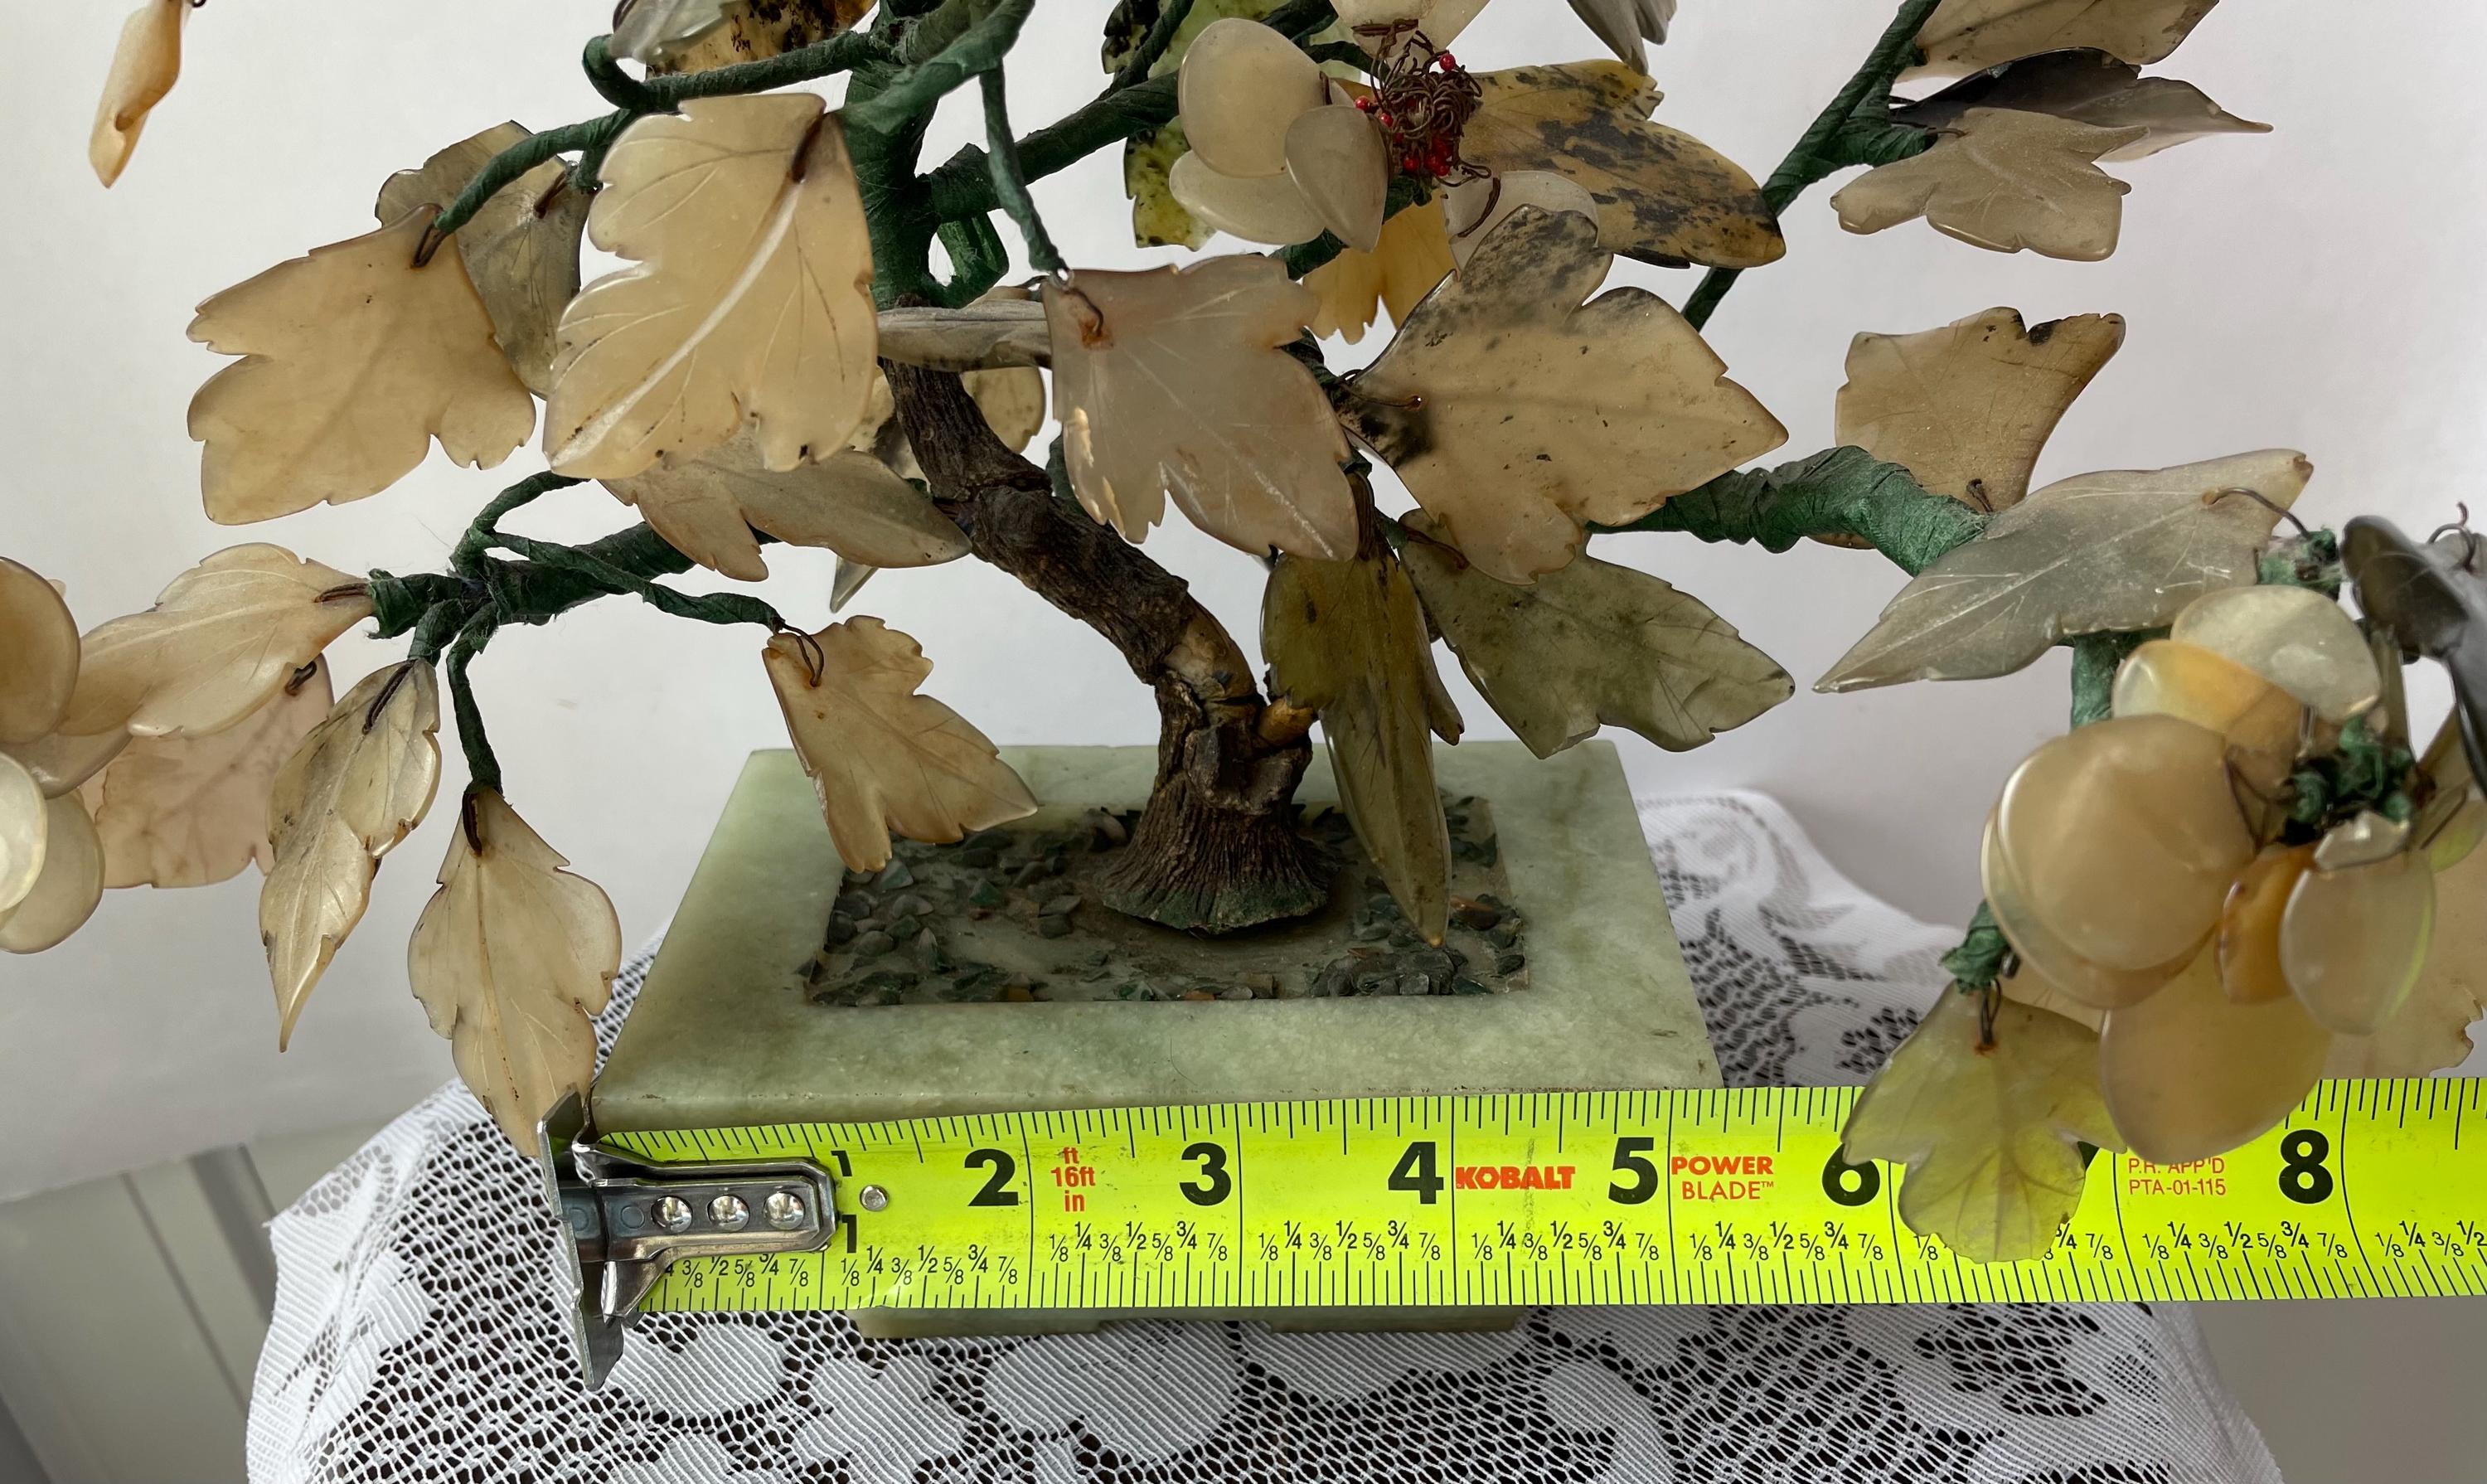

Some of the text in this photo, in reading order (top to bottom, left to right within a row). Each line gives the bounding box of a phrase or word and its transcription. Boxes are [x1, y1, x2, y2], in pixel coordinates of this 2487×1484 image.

[831, 1150, 853, 1177] 1
[1063, 1147, 1079, 1164] ft
[1179, 1142, 1232, 1206] 3
[1388, 1141, 1444, 1205] 4
[1607, 1137, 1659, 1205] 5
[1671, 1156, 1774, 1176] POWER
[1822, 1142, 1880, 1207] 6
[2278, 1128, 2334, 1205] 8
[964, 1148, 1019, 1207] 2
[1050, 1166, 1096, 1187] 16ft
[1455, 1166, 1576, 1190] KOBALT
[2129, 1178, 2227, 1195] PTA-01-115
[1064, 1189, 1085, 1212] in
[841, 1214, 858, 1254] 1
[1050, 1221, 1227, 1262] 1/8 1/4 3/8 1/2 5/8 3/4 7/8
[1259, 1220, 1440, 1260] 1/8 1/4 3/8 1/2 5/8 3/4 7/8
[1472, 1221, 1659, 1260] 1/8 1/4 3/8 1/2 5/8 3/4 7/8
[1690, 1221, 1883, 1260] 1/8 1/4 3/8 1/2 5/8 3/4 7/8
[2086, 1234, 2113, 1259] 7/8
[2143, 1221, 2347, 1259] 1/8 1/4 3/8 1/2 5/8 3/4 7/8
[2375, 1220, 2486, 1257] 1/8 1/4 3/8 1/2
[682, 1259, 703, 1288] 3/8
[734, 1259, 754, 1288] 5/8
[789, 1258, 808, 1288] 7/8
[841, 1244, 1017, 1286] 1/8 1/4 3/8 1/2 5/8 3/4 7/8
